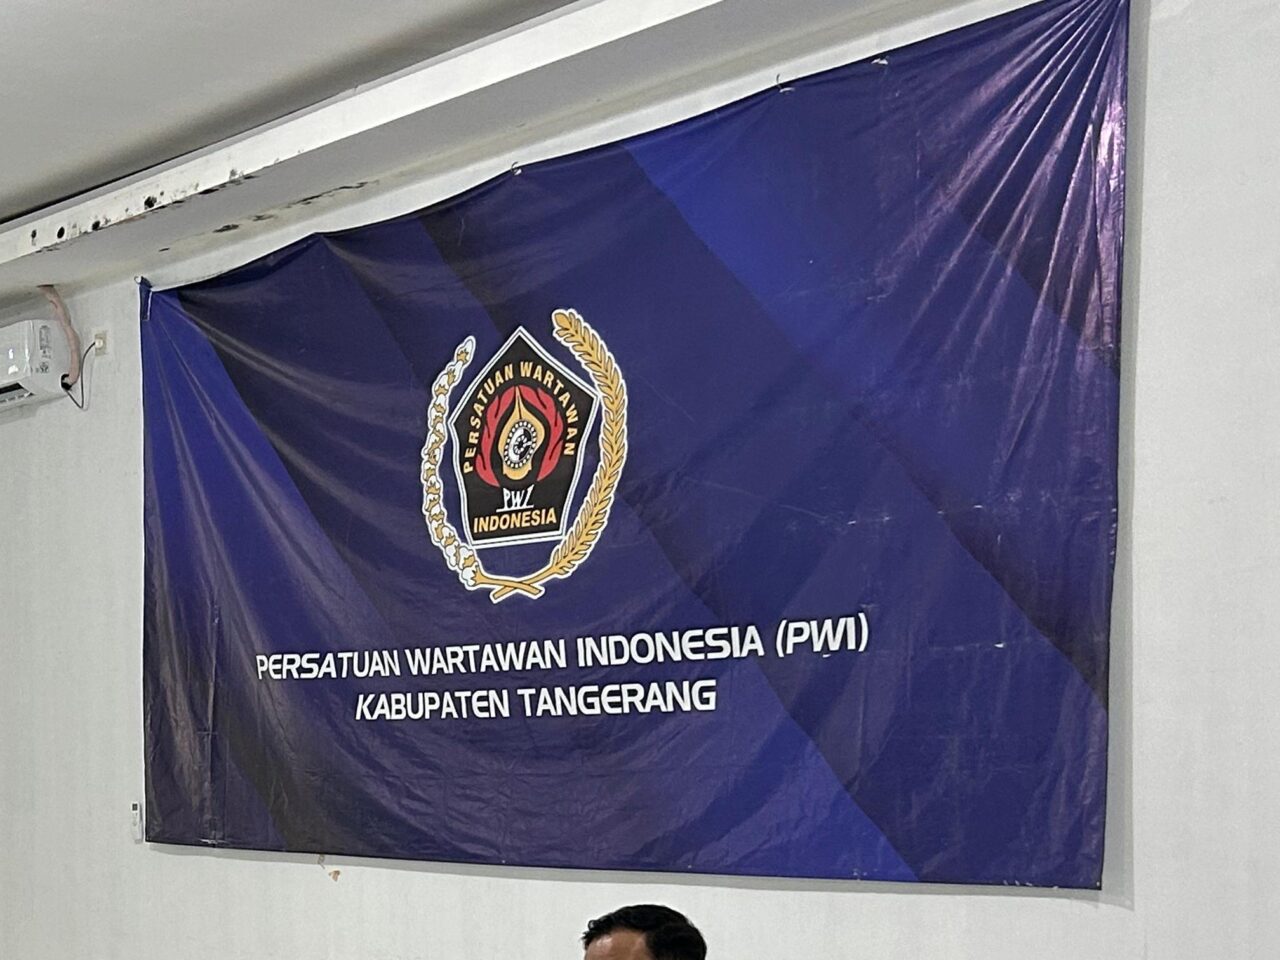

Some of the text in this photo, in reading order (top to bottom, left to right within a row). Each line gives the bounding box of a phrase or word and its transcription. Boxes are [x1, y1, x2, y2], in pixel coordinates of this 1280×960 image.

[463, 361, 578, 474] PERSATUAN WARTAWAN
[473, 507, 557, 534] INDONESIA
[256, 612, 869, 680] PERSATUAN WARTAWAN INDONESIA (PWI)
[355, 679, 717, 720] KABUPATEN TANGERANG
